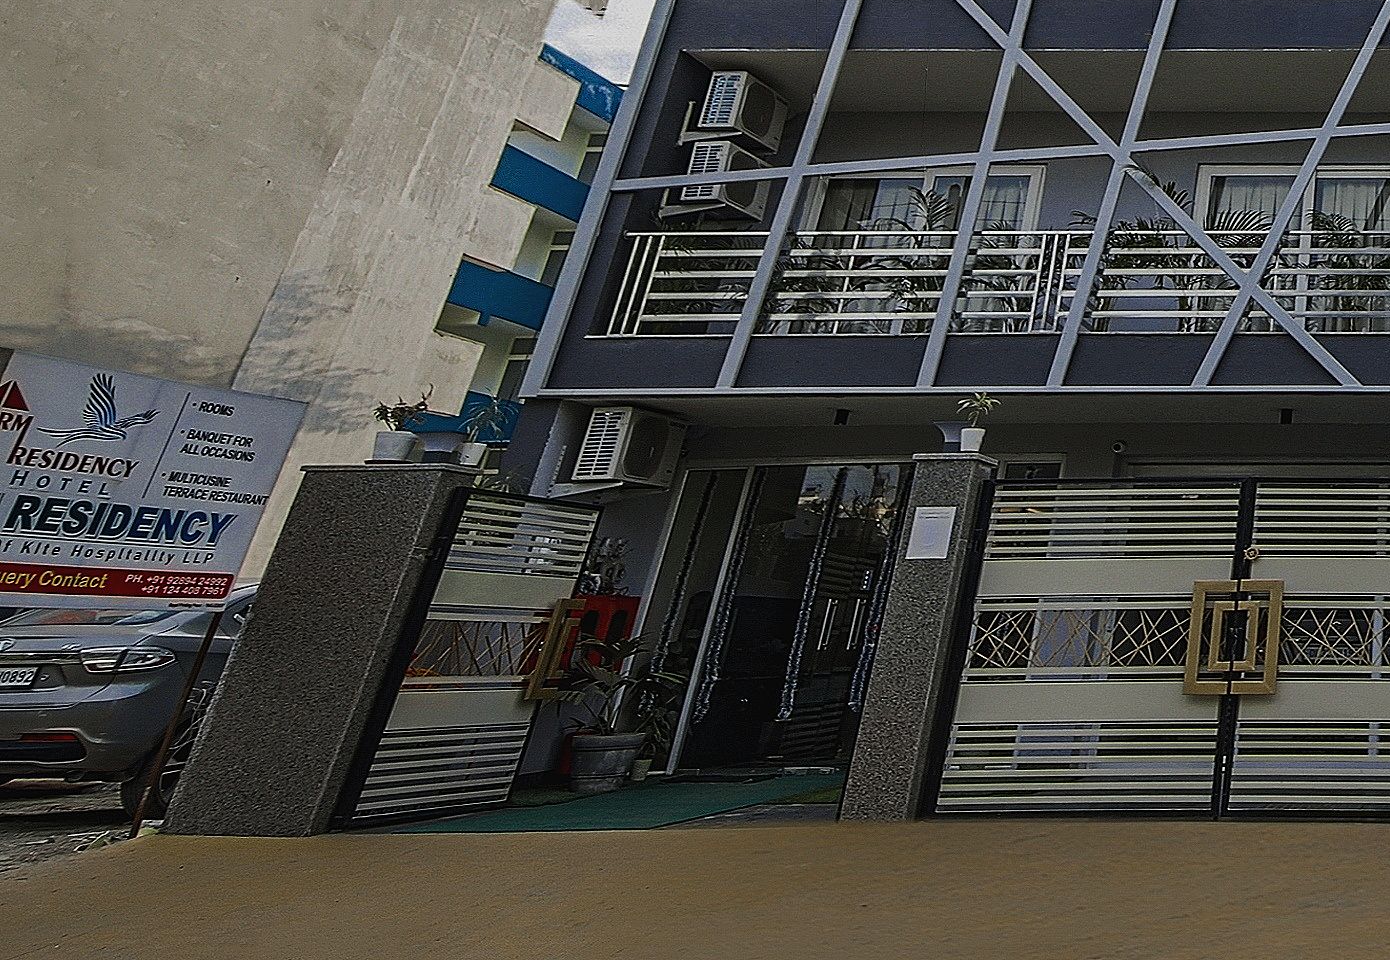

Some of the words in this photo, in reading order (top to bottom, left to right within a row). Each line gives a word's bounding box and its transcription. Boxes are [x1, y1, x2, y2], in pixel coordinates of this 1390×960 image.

[199, 401, 235, 416] ROOMS
[0, 411, 34, 432] RM
[186, 429, 233, 445] BANQUET
[232, 435, 254, 447] FOR
[6, 446, 140, 478] RESIDENCY
[180, 443, 199, 455] ALL
[201, 446, 256, 462] OCCASIONS
[9, 470, 110, 496] HOTEL
[163, 486, 209, 500] TERRACE
[208, 490, 270, 506] RESTAURANT
[2, 494, 236, 546] RESIDENCY
[20, 541, 61, 555] Kite
[70, 544, 175, 565] Hospitality
[182, 551, 214, 564] LLP
[38, 570, 108, 588] Contact
[125, 574, 144, 584] PH.
[146, 575, 165, 584] +91
[141, 585, 160, 594] +91
[0, 669, 34, 683] 0892
